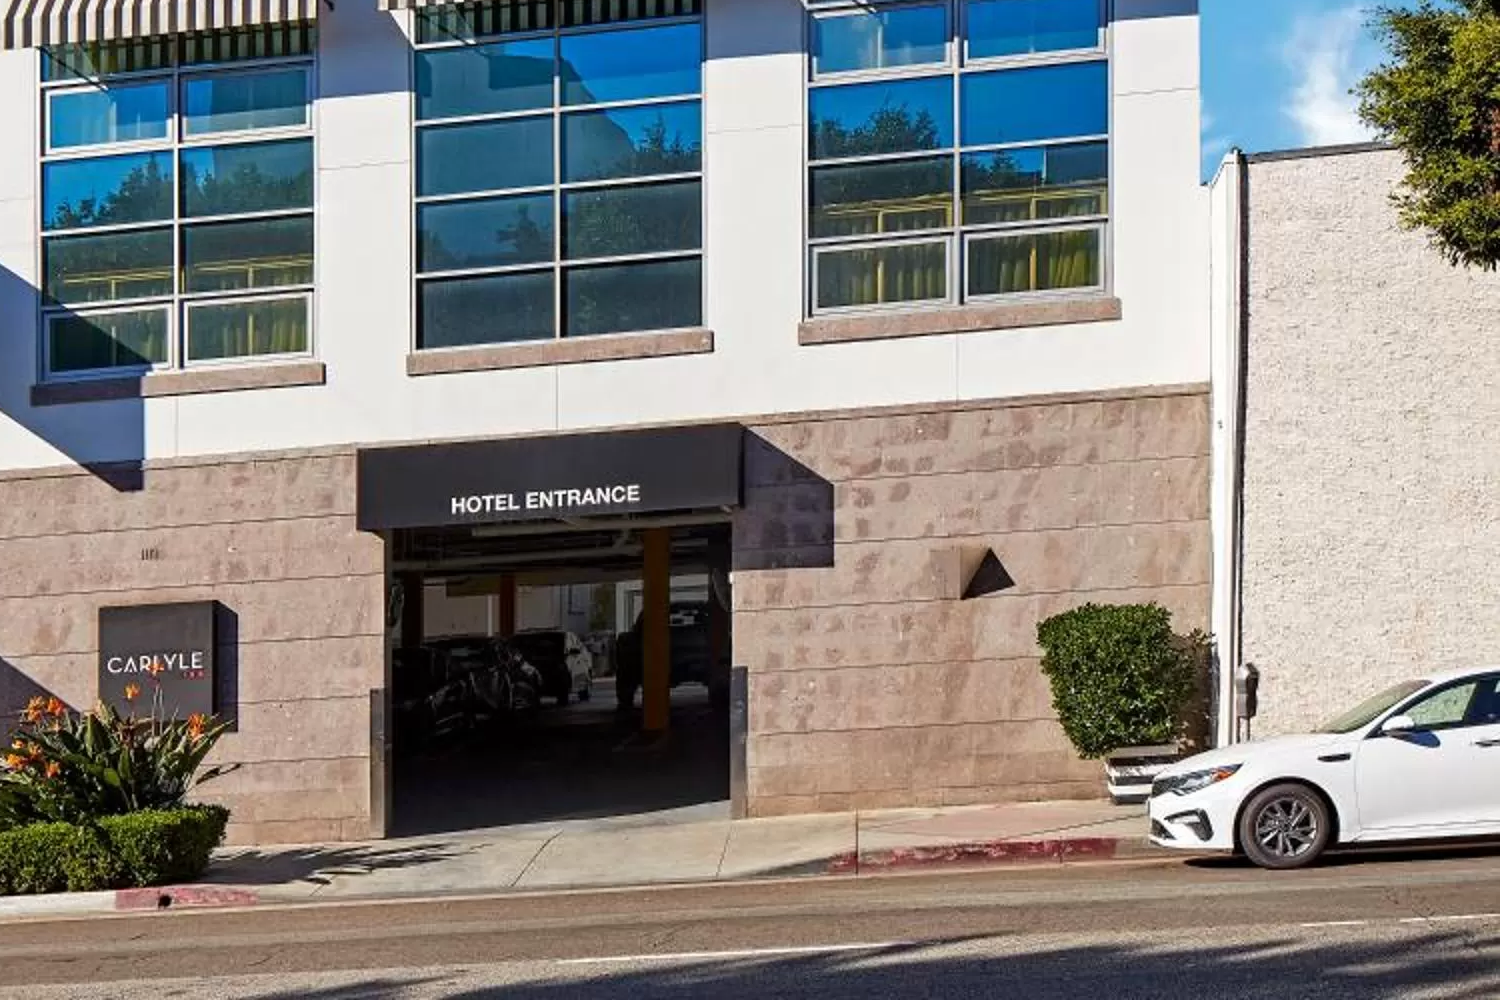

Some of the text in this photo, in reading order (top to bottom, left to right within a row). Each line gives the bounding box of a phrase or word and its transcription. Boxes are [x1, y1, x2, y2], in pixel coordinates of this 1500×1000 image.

[451, 484, 641, 515] HOTEL ENTRANCE
[106, 651, 204, 674] CARLYLE
